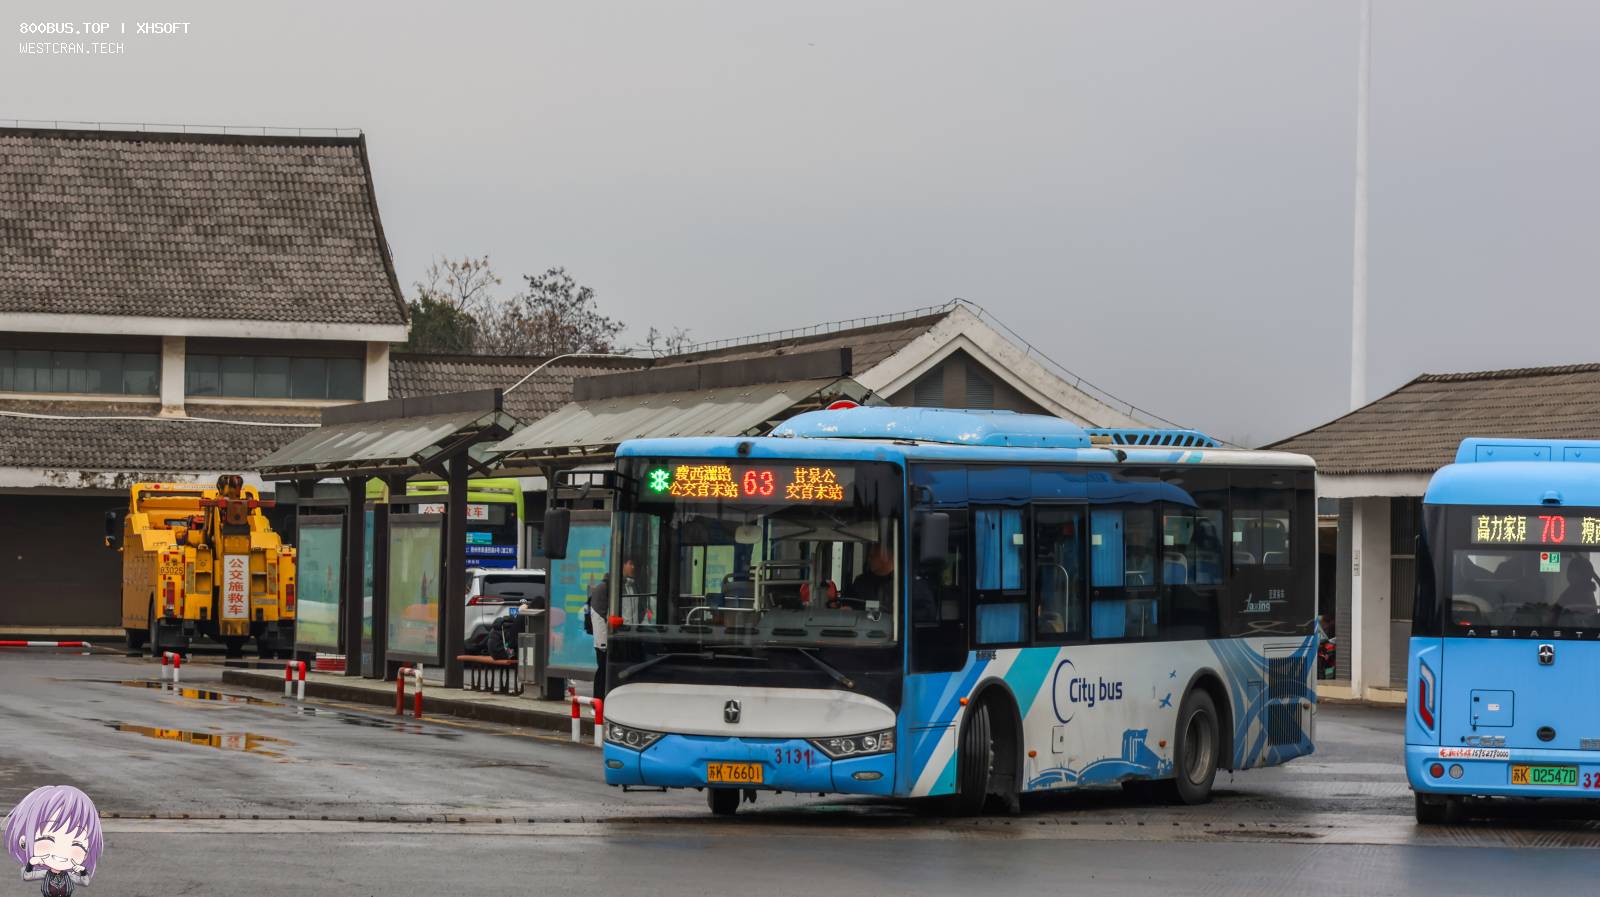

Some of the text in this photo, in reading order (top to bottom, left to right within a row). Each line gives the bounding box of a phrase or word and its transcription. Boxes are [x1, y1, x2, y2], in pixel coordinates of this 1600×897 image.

[743, 470, 775, 496] 63
[793, 467, 836, 484] 甘泉公
[670, 481, 739, 498] 公交首末站
[785, 484, 844, 501] 交首末站
[1538, 515, 1566, 544] 70
[228, 558, 244, 615] 公交施救车
[1069, 676, 1123, 708] City bus
